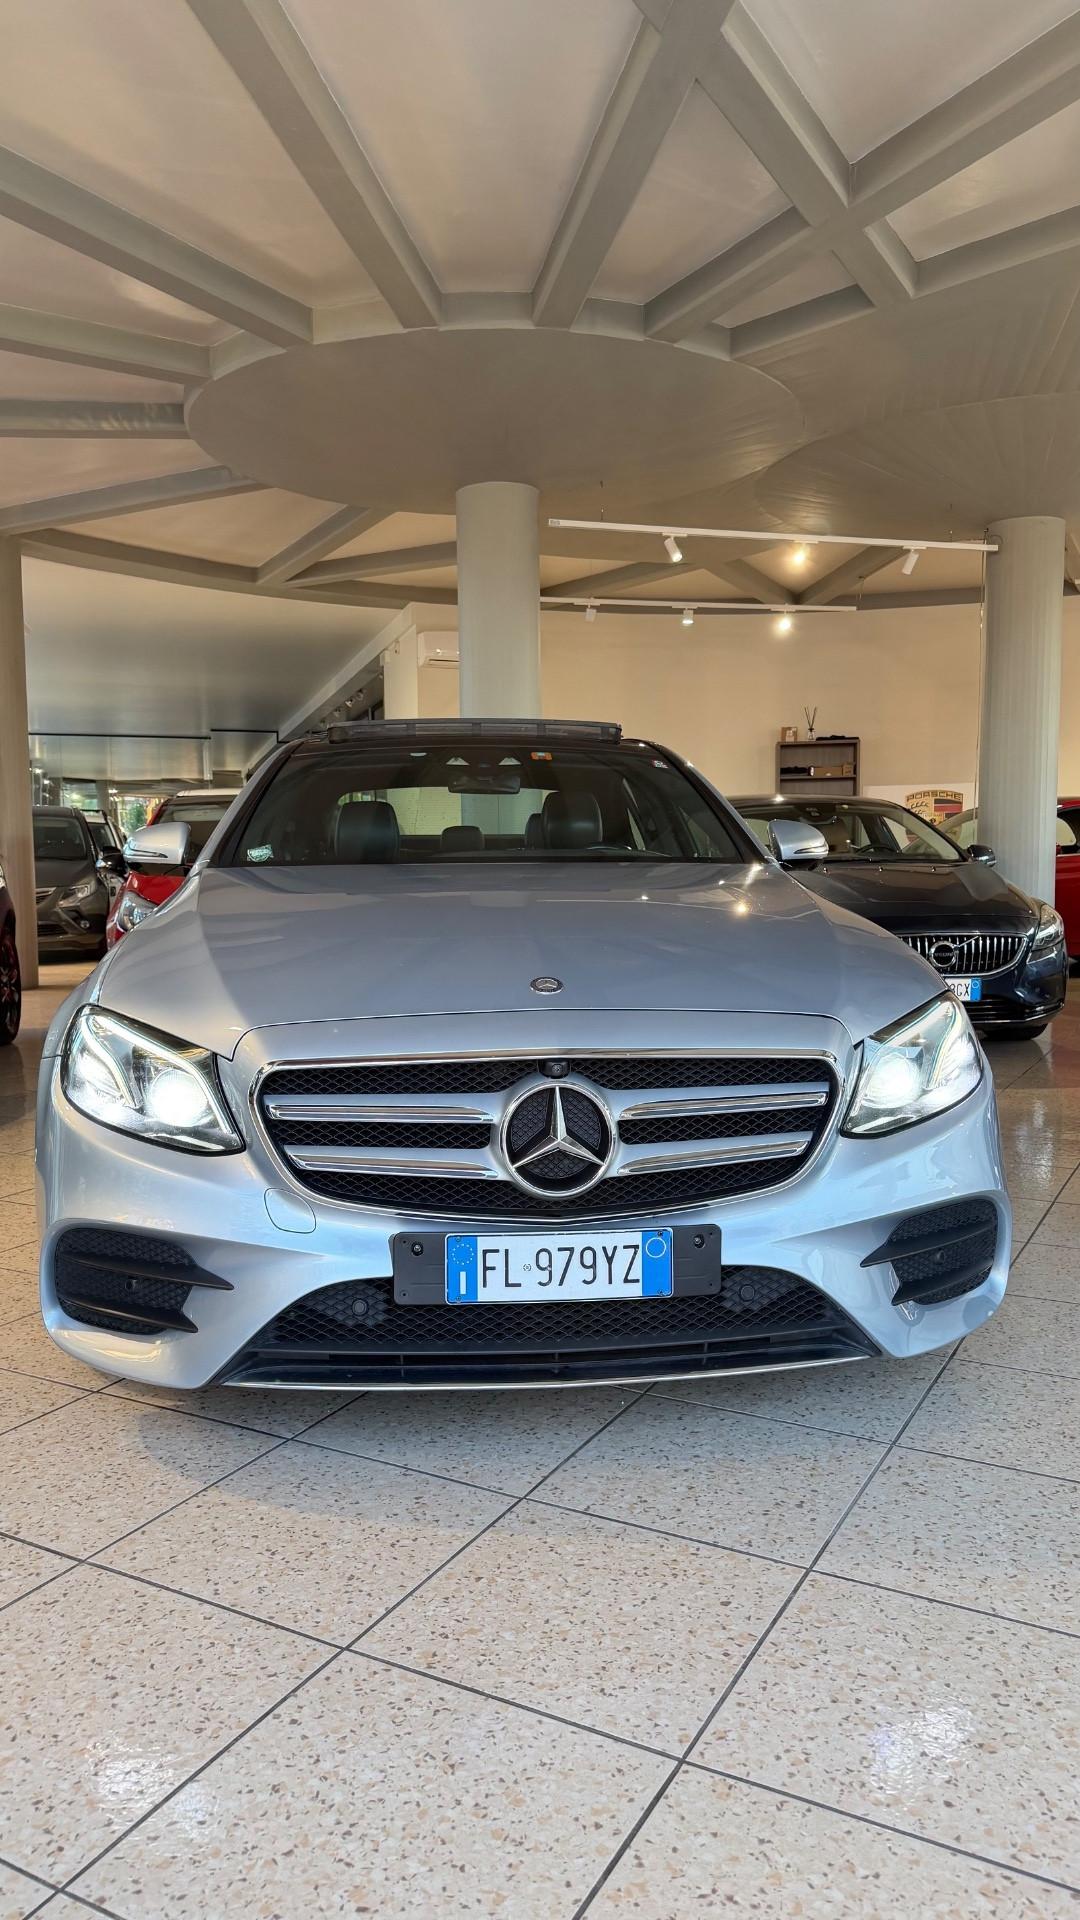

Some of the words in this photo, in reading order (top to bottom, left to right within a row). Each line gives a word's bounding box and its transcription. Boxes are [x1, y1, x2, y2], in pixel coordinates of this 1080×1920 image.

[907, 791, 961, 802] PORSCHE
[482, 1248, 521, 1288] FL
[535, 1244, 640, 1287] 979YZ
